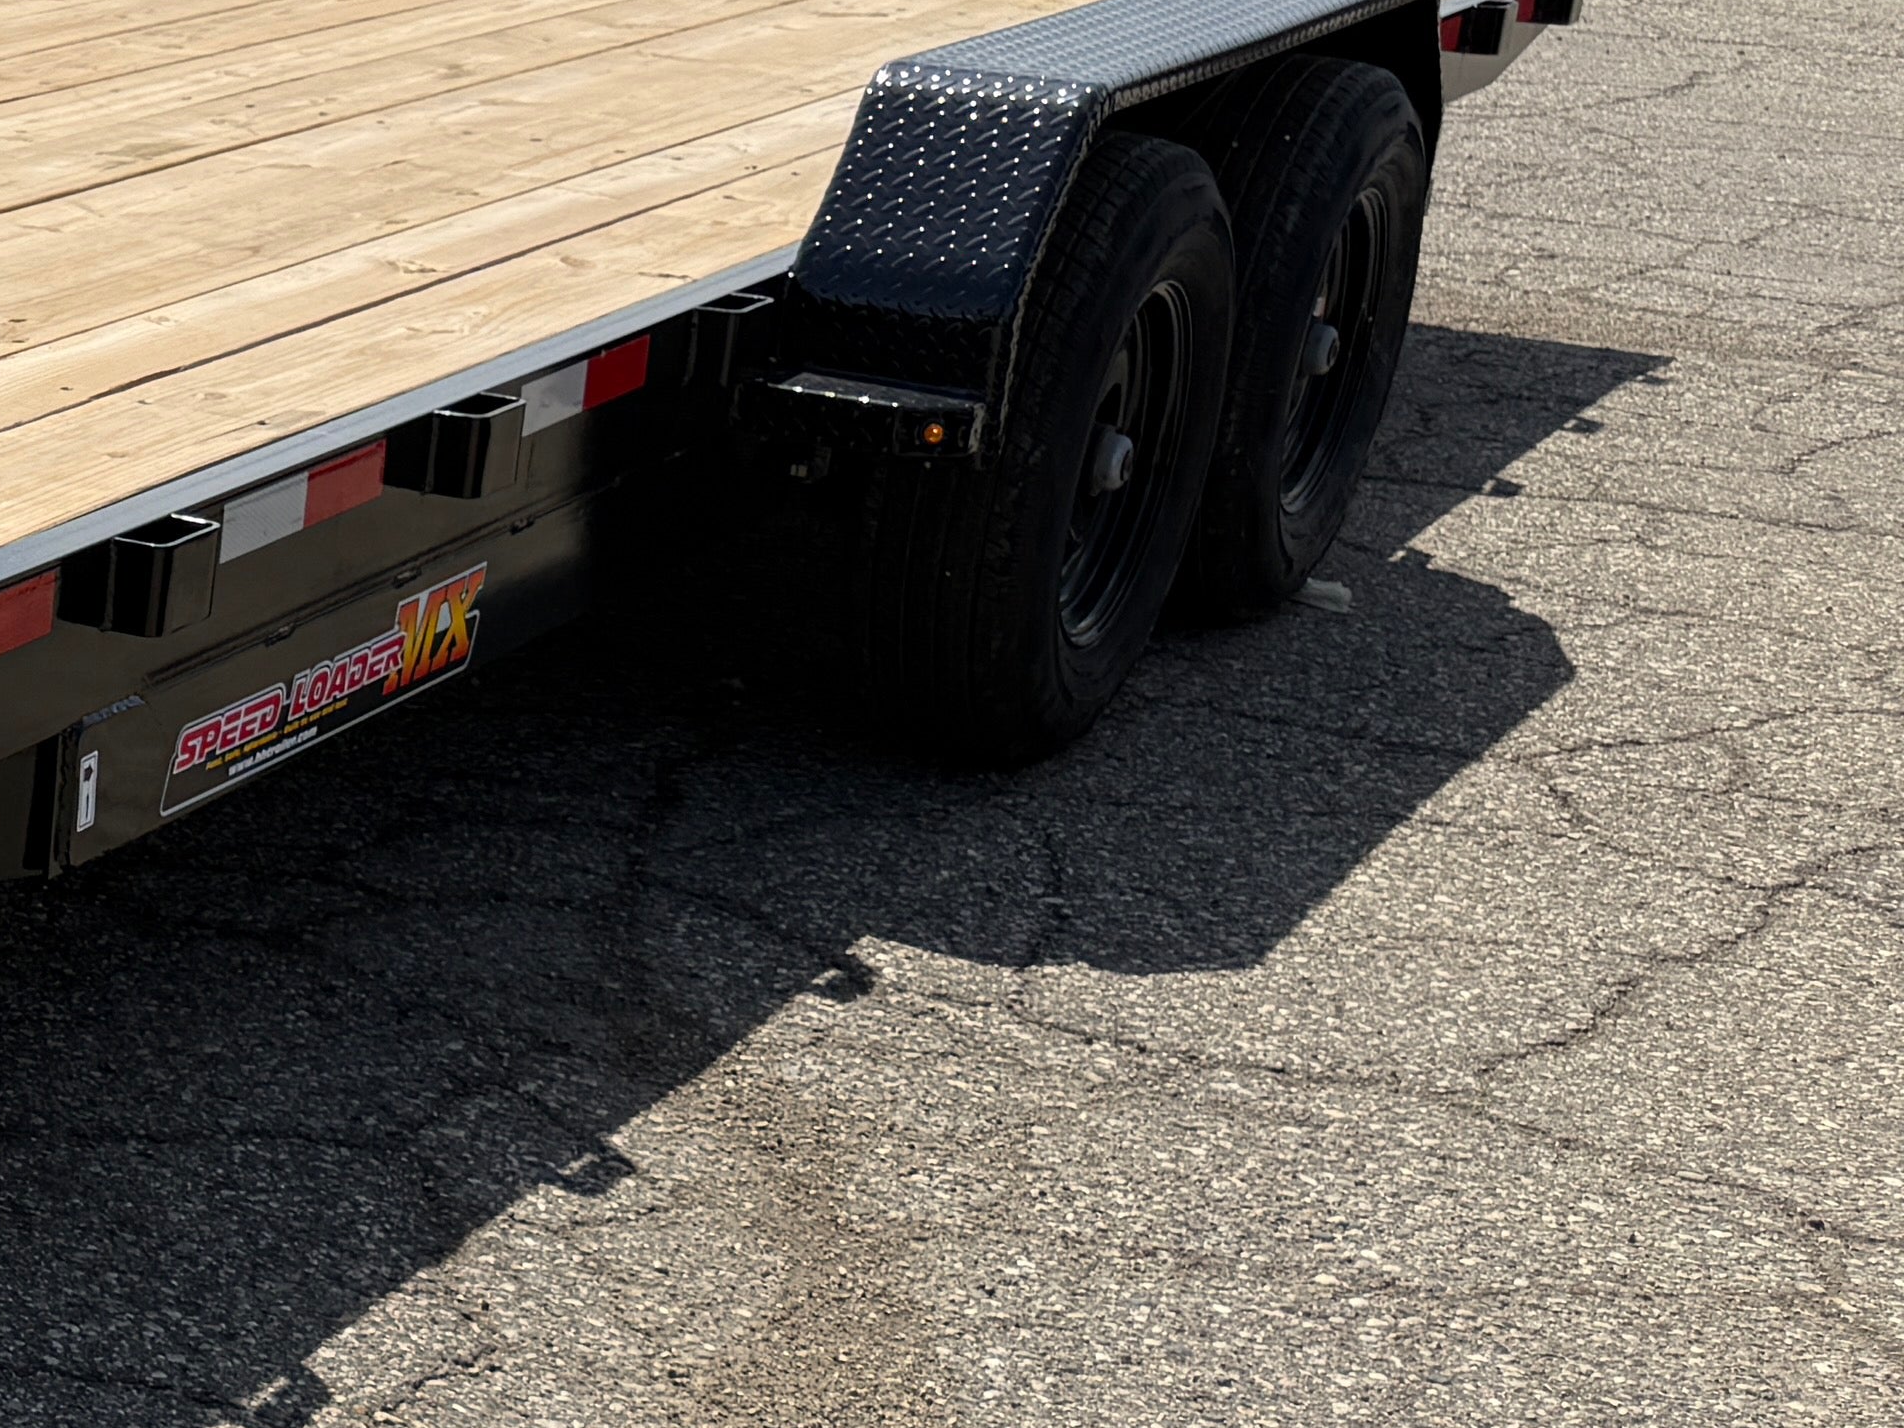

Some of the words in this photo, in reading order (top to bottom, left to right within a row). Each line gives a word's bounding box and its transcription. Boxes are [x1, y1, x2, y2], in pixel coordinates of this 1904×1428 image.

[173, 687, 284, 774] SPEED
[288, 631, 407, 722] LOADER
[383, 564, 486, 696] MX
